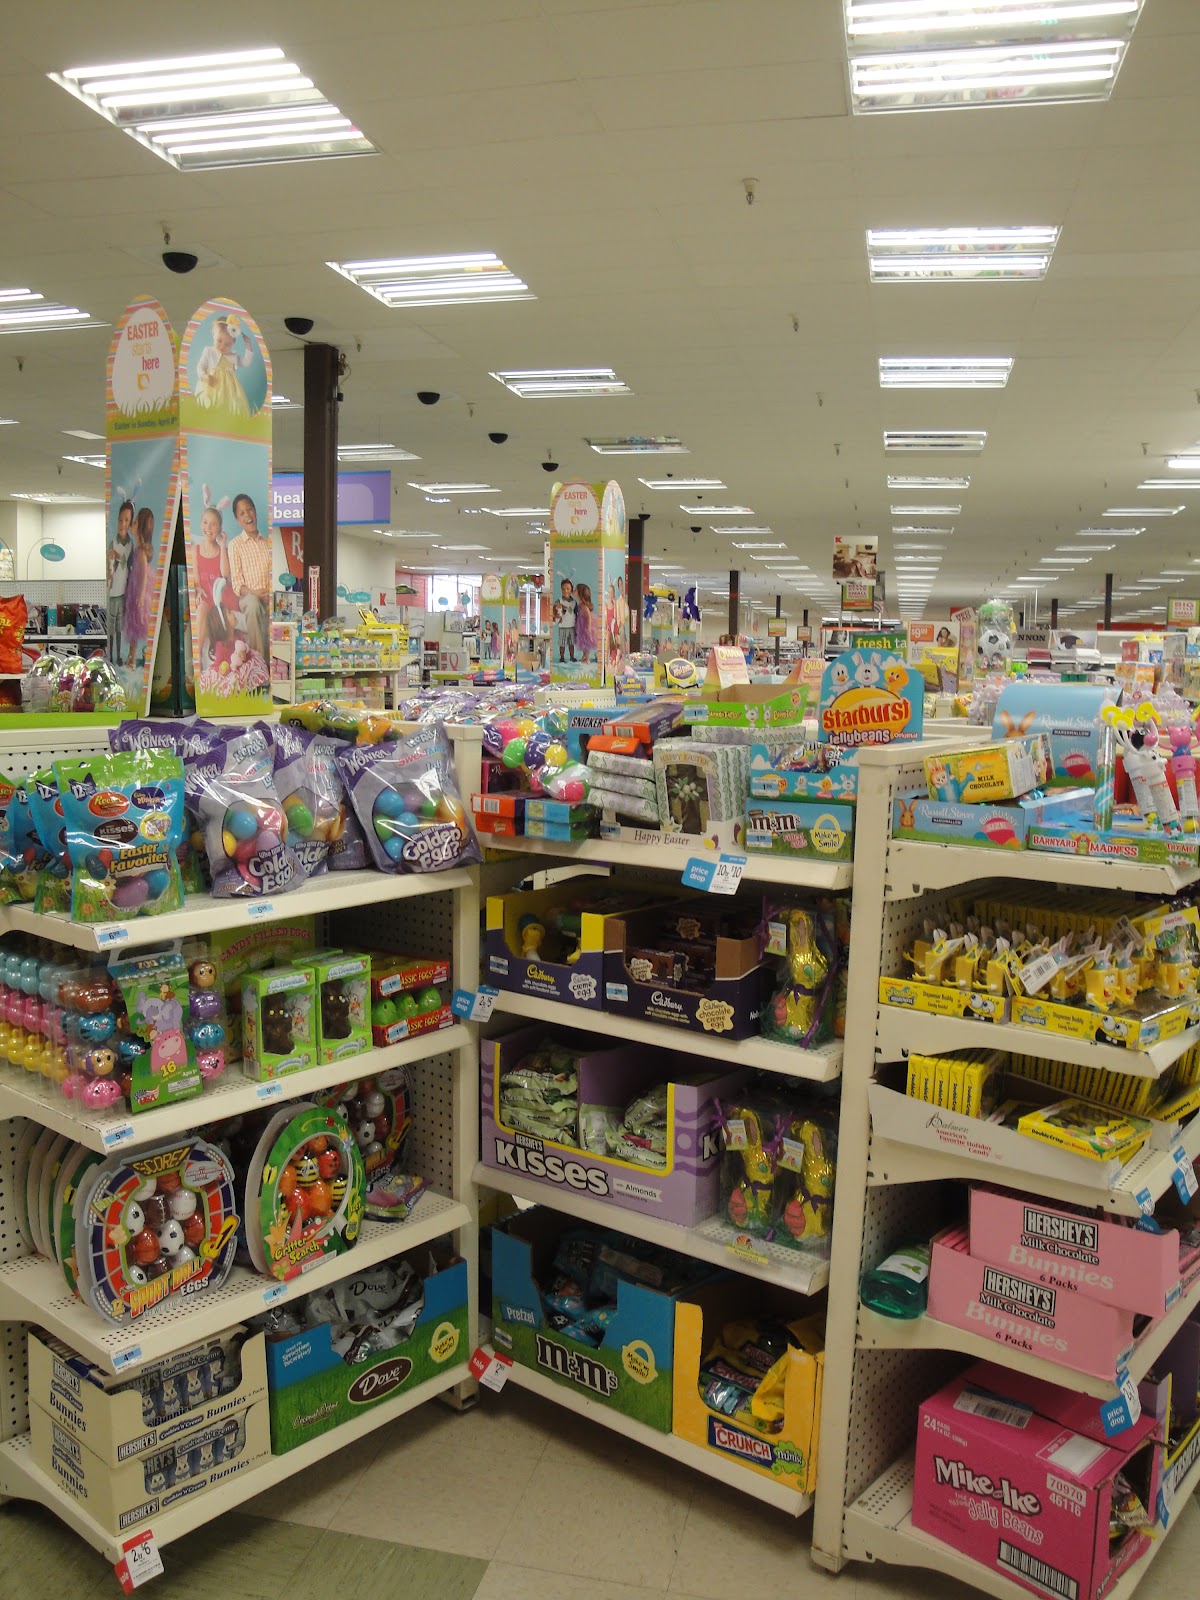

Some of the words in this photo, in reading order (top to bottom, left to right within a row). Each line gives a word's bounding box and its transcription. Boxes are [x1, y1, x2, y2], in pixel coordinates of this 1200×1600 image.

[127, 320, 159, 341] EASTER
[142, 356, 160, 371] here
[273, 491, 304, 504] heal
[564, 491, 588, 500] EASTER
[856, 637, 891, 649] fresh
[823, 698, 910, 729] Starburst
[1038, 714, 1073, 728] Russell
[829, 729, 890, 746] Jellybeans
[1053, 729, 1090, 737] MARSHMALLOW
[969, 780, 1005, 790] CHOCOLATE
[918, 804, 949, 818] Russell
[948, 805, 976, 819] Stover
[979, 812, 992, 824] BIG
[987, 822, 1007, 831] SIZE
[402, 827, 462, 861] Golden
[634, 830, 661, 845] Happy
[664, 832, 690, 845] Easter
[818, 839, 840, 849] Smile!
[120, 843, 158, 860] Easter
[1033, 835, 1077, 848] BARNYARD
[1089, 842, 1138, 857] MADNESS
[1166, 842, 1180, 852] TRY
[110, 852, 167, 874] Favorites
[690, 865, 709, 876] price
[717, 864, 726, 876] 10
[689, 873, 706, 883] drop
[220, 936, 252, 962] CANDY
[253, 928, 288, 943] FILLED
[290, 928, 311, 939] EGGS
[418, 970, 434, 980] EGGS!
[527, 964, 555, 983] Cadbury
[572, 982, 592, 990] creme
[577, 989, 592, 997] egg
[456, 996, 470, 1005] price
[456, 1003, 468, 1012] drop
[651, 991, 683, 1012] Cadbury
[703, 1001, 724, 1010] Cadbury
[424, 1014, 440, 1027] EGGS!
[699, 1007, 731, 1018] chocolate
[706, 1015, 725, 1023] creme
[710, 1021, 725, 1030] egg
[161, 1061, 176, 1077] 16
[515, 1133, 543, 1151] HERSHEY'S
[936, 1128, 967, 1140] America's
[939, 1135, 965, 1146] Favorite
[966, 1140, 992, 1151] Holiday
[968, 1147, 990, 1157] Candy
[625, 1184, 657, 1198] Almonds
[1028, 1211, 1094, 1247] HERSHEY'S
[275, 1238, 307, 1260] Critter
[289, 1240, 319, 1265] Search
[1021, 1235, 1046, 1251] Milk
[1046, 1242, 1099, 1265] Chocolate
[1008, 1245, 1114, 1289] Bunnies
[130, 1274, 170, 1318] SPORT
[172, 1258, 203, 1289] BALL
[180, 1276, 209, 1297] EGGS
[349, 1281, 387, 1296] Dove
[1039, 1274, 1046, 1282] 6
[1049, 1276, 1078, 1291] Packs
[987, 1271, 1051, 1311] HERSHEY'S
[112, 1299, 124, 1311] 12
[980, 1292, 1004, 1310] Milk
[1004, 1302, 1055, 1328] Chocolate
[507, 1307, 534, 1324] Pretzel
[965, 1300, 1069, 1352] Bunnies
[995, 1331, 1001, 1339] 6
[1005, 1335, 1033, 1350] Packs
[472, 1357, 484, 1371] sale
[537, 1335, 618, 1395] m&m's
[628, 1361, 649, 1378] Smile!
[359, 1366, 400, 1395] Dove
[50, 1391, 86, 1432] Bunnies
[154, 1405, 192, 1426] Bunnies
[1107, 1406, 1123, 1421] price
[63, 1418, 77, 1433] Packs
[120, 1435, 155, 1457] HERSHEY'S
[206, 1396, 246, 1419] Bunnies
[252, 1386, 265, 1395] Packs
[924, 1415, 937, 1431] 24
[1110, 1415, 1126, 1427] drop
[716, 1428, 770, 1458] CRUNCH
[145, 1446, 176, 1472] HEY'S
[52, 1455, 88, 1498] Bunnies
[65, 1484, 79, 1500] Packs
[121, 1502, 157, 1526] HERSHEY'S
[209, 1457, 250, 1483] Bunnies
[256, 1450, 269, 1460] Packs
[934, 1456, 994, 1495] Mike
[1000, 1478, 1042, 1516] Ike
[1049, 1492, 1081, 1517] 46116
[969, 1500, 998, 1528] Jelly
[1002, 1508, 1043, 1545] Beans
[131, 1549, 138, 1562] 2
